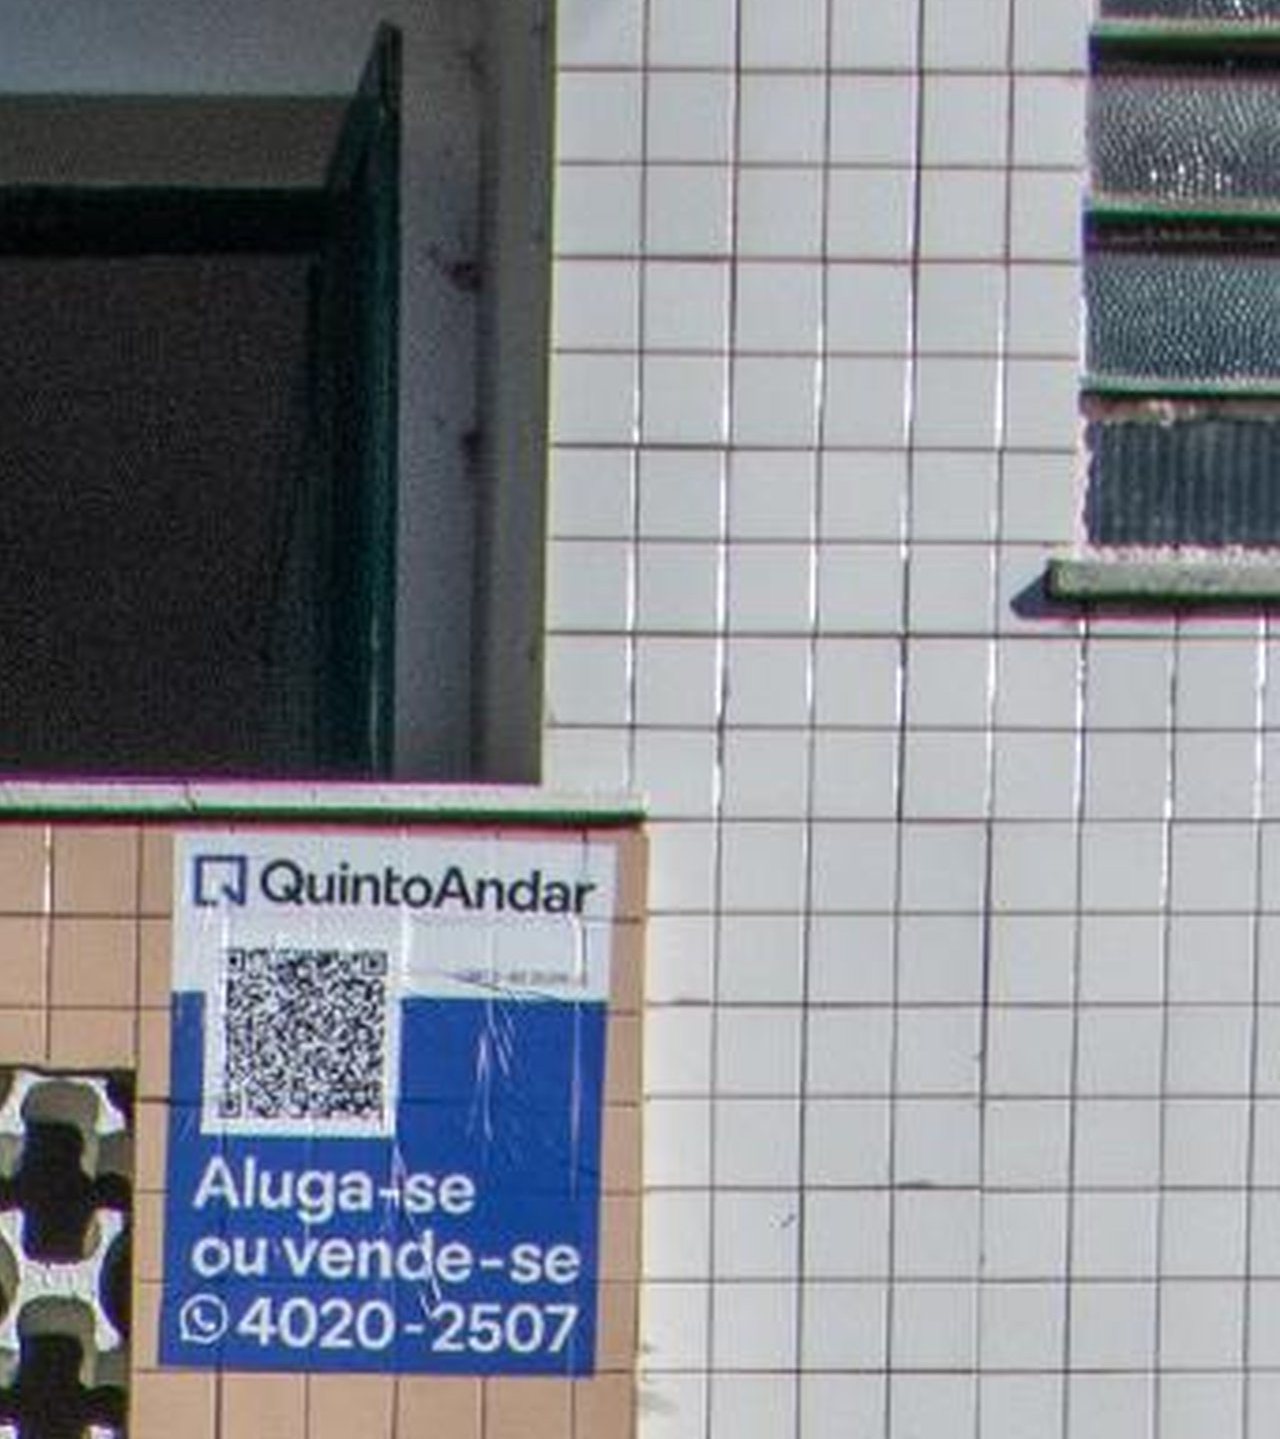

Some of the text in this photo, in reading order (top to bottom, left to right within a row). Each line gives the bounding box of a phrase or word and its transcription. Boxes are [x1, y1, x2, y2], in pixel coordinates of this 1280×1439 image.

[258, 858, 596, 914] QuintoAndar
[192, 1157, 475, 1223] Aluga-se
[191, 1229, 581, 1283] ou vende-se
[238, 1296, 578, 1352] 4020-2507
